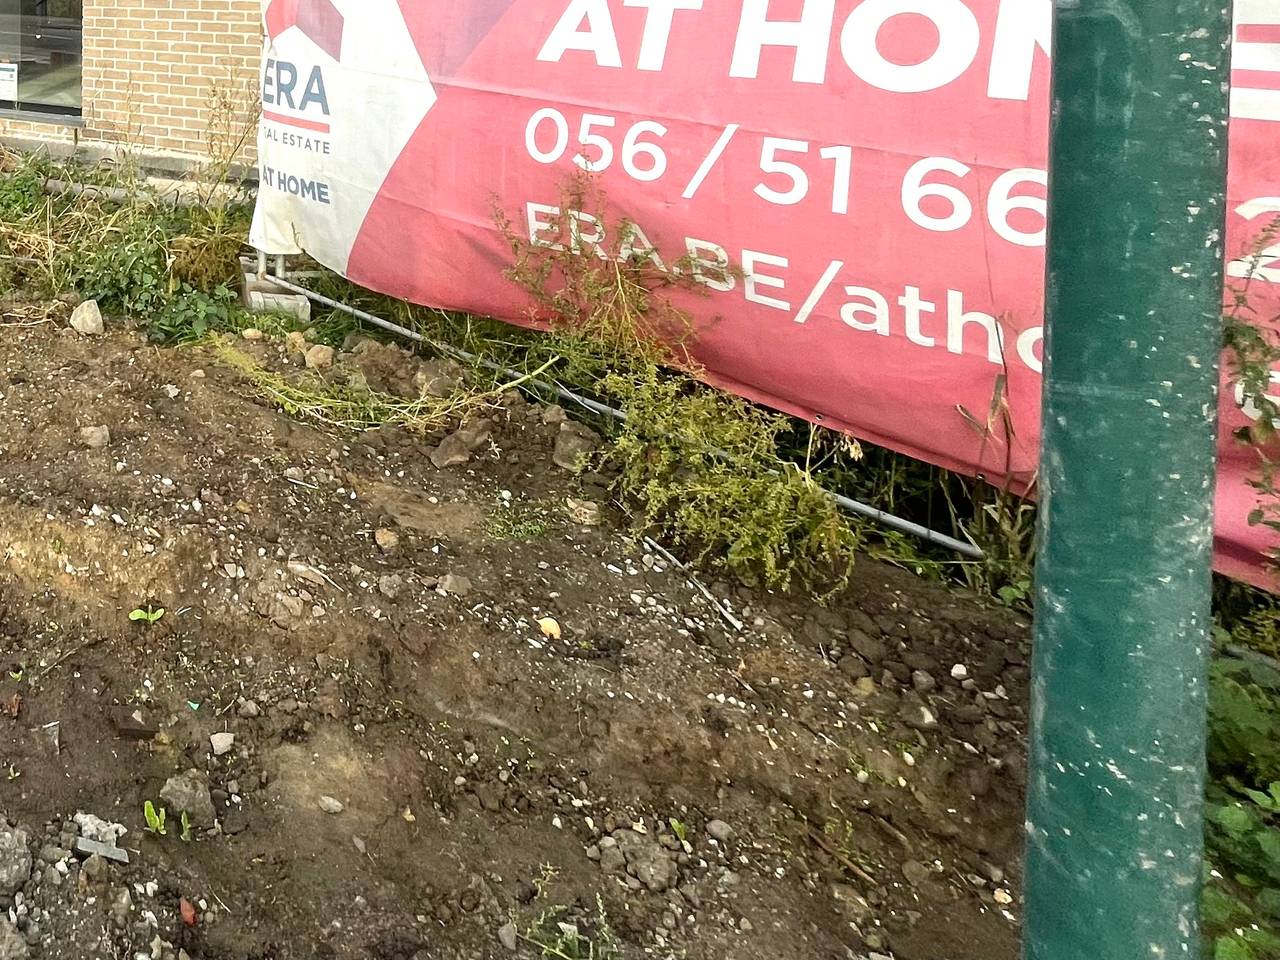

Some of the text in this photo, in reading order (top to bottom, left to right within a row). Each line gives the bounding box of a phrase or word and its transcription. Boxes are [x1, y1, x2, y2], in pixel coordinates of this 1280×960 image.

[262, 58, 331, 116] ERA
[282, 132, 330, 154] ESTATE
[263, 164, 331, 205] AT HOME
[525, 107, 668, 182] 056
[681, 123, 740, 199] /
[753, 137, 853, 215] 51
[901, 156, 1048, 247] 66
